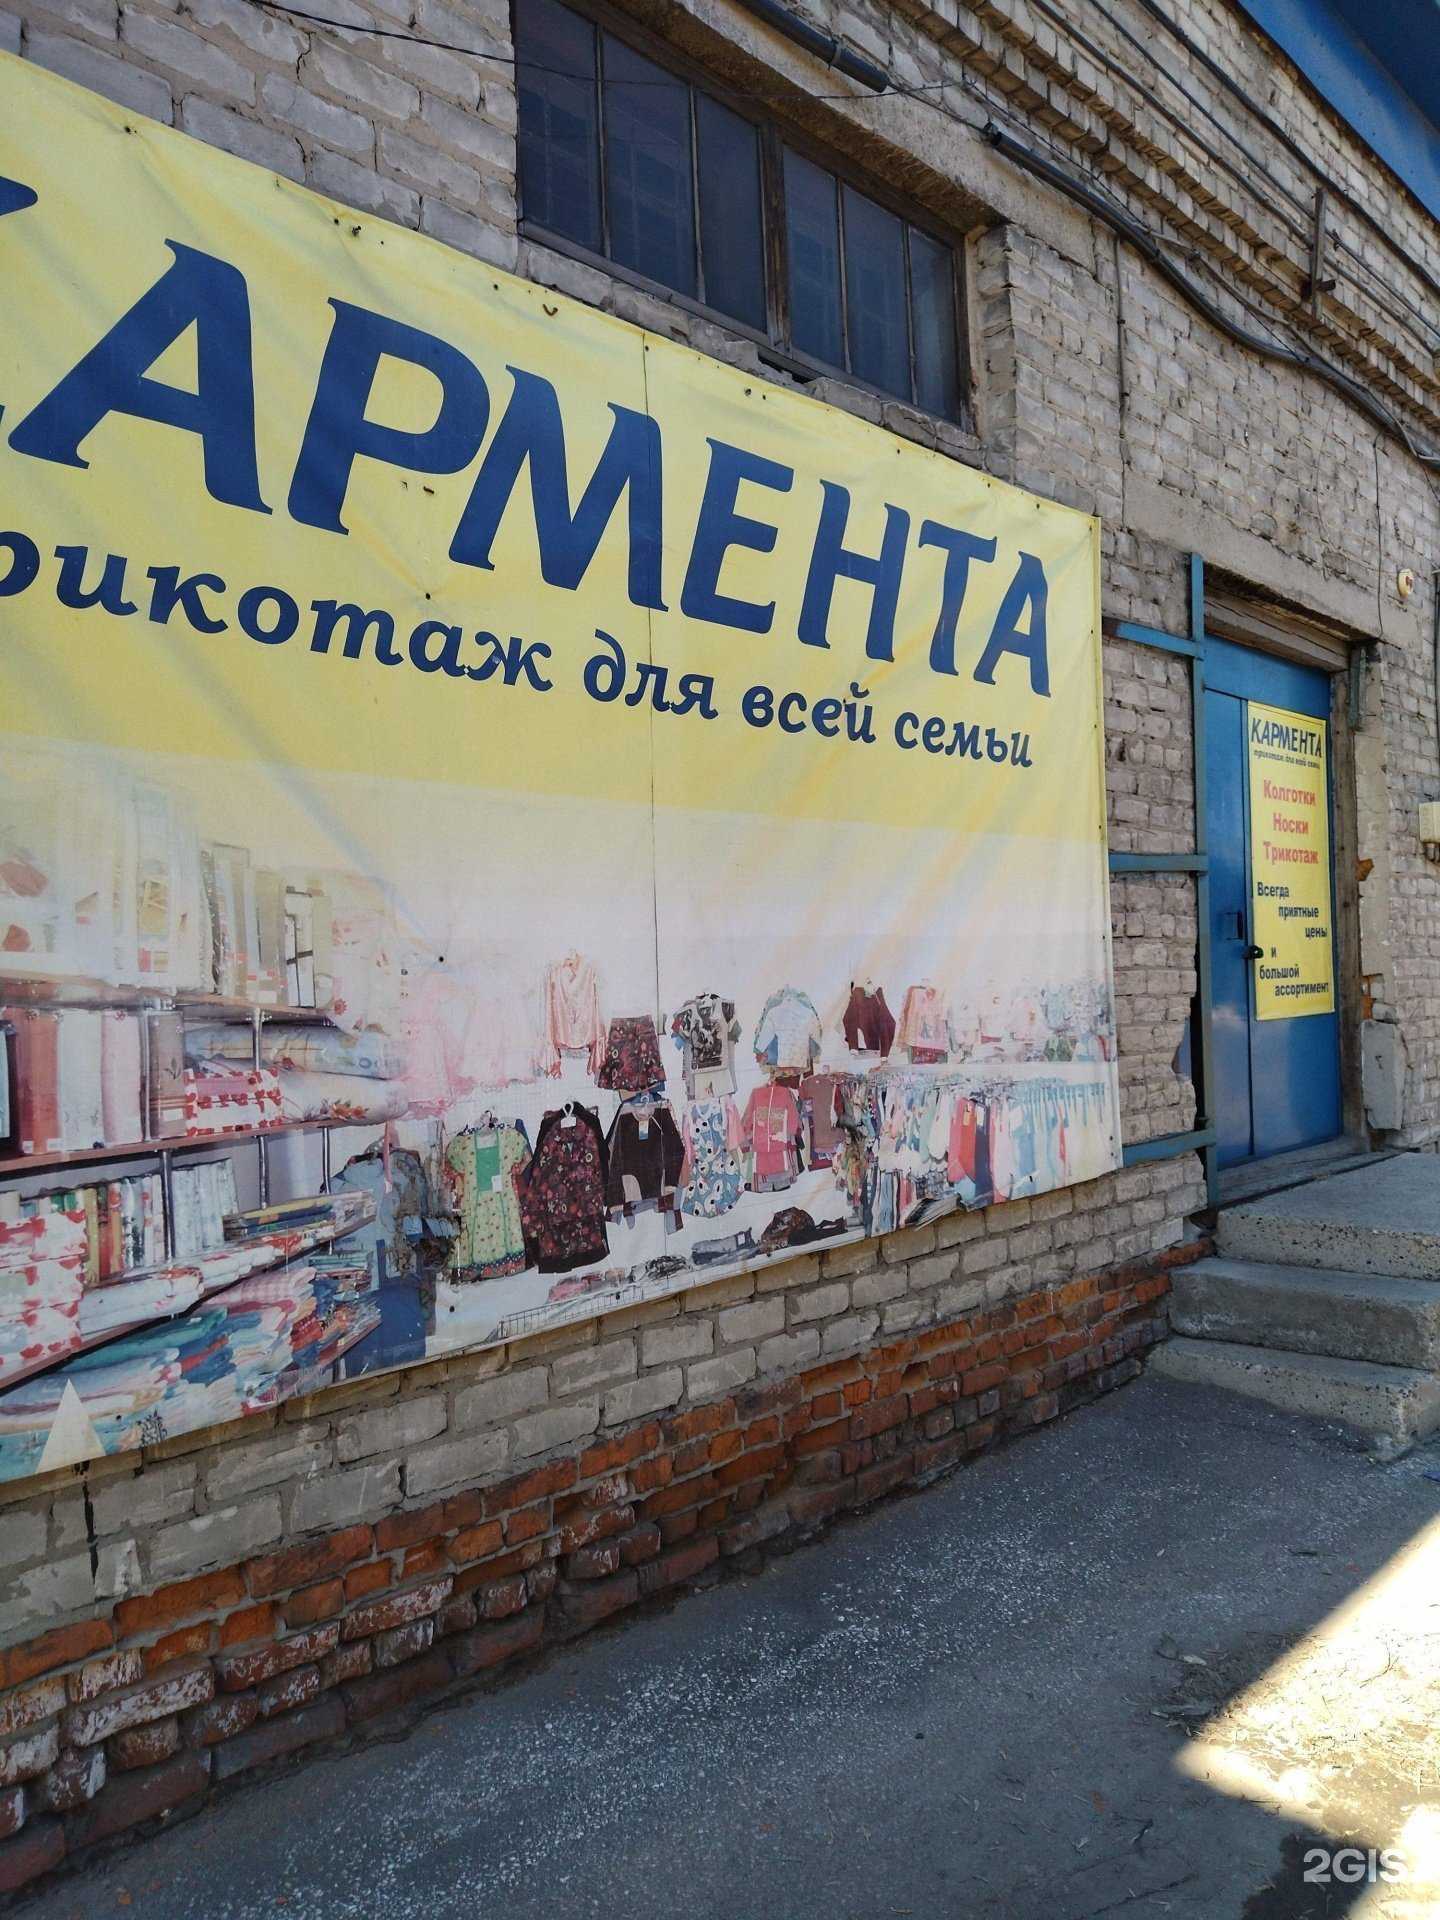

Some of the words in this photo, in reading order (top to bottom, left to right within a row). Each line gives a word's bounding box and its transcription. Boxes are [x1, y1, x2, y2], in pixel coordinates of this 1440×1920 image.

[0, 175, 1052, 698] АРМЕНТА
[583, 628, 719, 720] для
[742, 681, 877, 744] всей
[893, 710, 1033, 768] семьи
[1251, 717, 1322, 758] КАРМЕНТА
[1263, 779, 1316, 806] Колготки
[1273, 813, 1309, 834] Носки
[1263, 841, 1319, 865] Трикотаж
[1257, 881, 1289, 899] Всегда
[1278, 906, 1319, 920] приятные
[1305, 927, 1327, 940] цены
[1271, 946, 1277, 958] и
[1259, 963, 1300, 980] большой
[1275, 982, 1329, 998] ассортимент
